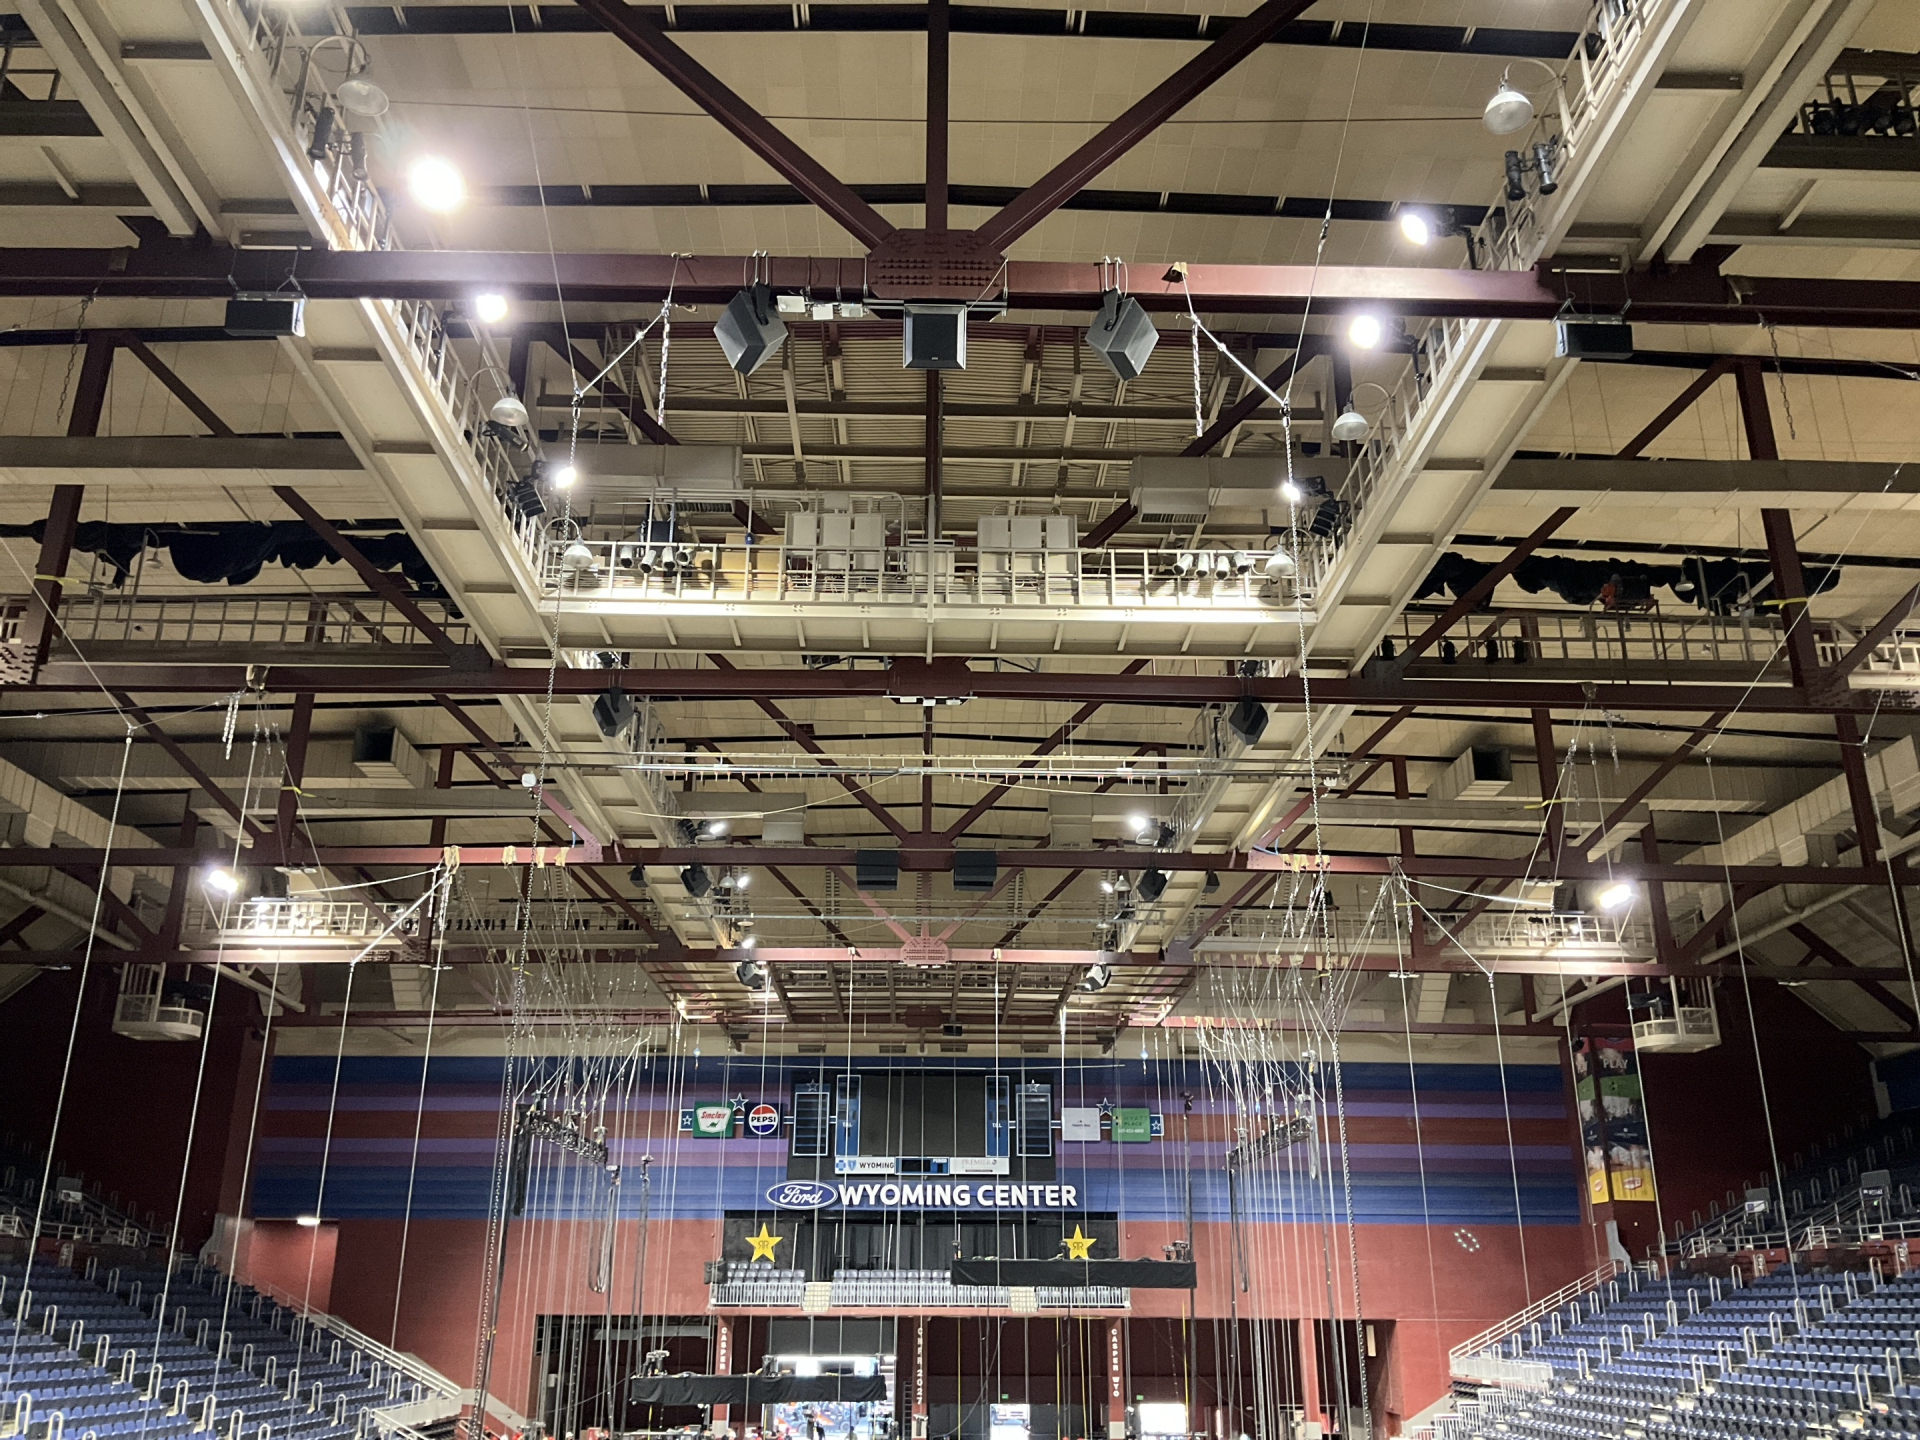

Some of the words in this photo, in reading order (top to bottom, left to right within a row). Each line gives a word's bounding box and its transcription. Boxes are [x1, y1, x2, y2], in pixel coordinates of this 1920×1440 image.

[1603, 1059, 1628, 1069] PLAY
[701, 1111, 727, 1119] Sinclair
[751, 1115, 776, 1123] PEPSI
[780, 1184, 823, 1204] Ford
[838, 1184, 971, 1206] WYOMING
[977, 1185, 1078, 1207] CENTER
[720, 1327, 728, 1370] CASPER
[1111, 1328, 1119, 1371] CASPER
[1112, 1377, 1120, 1397] WYO
